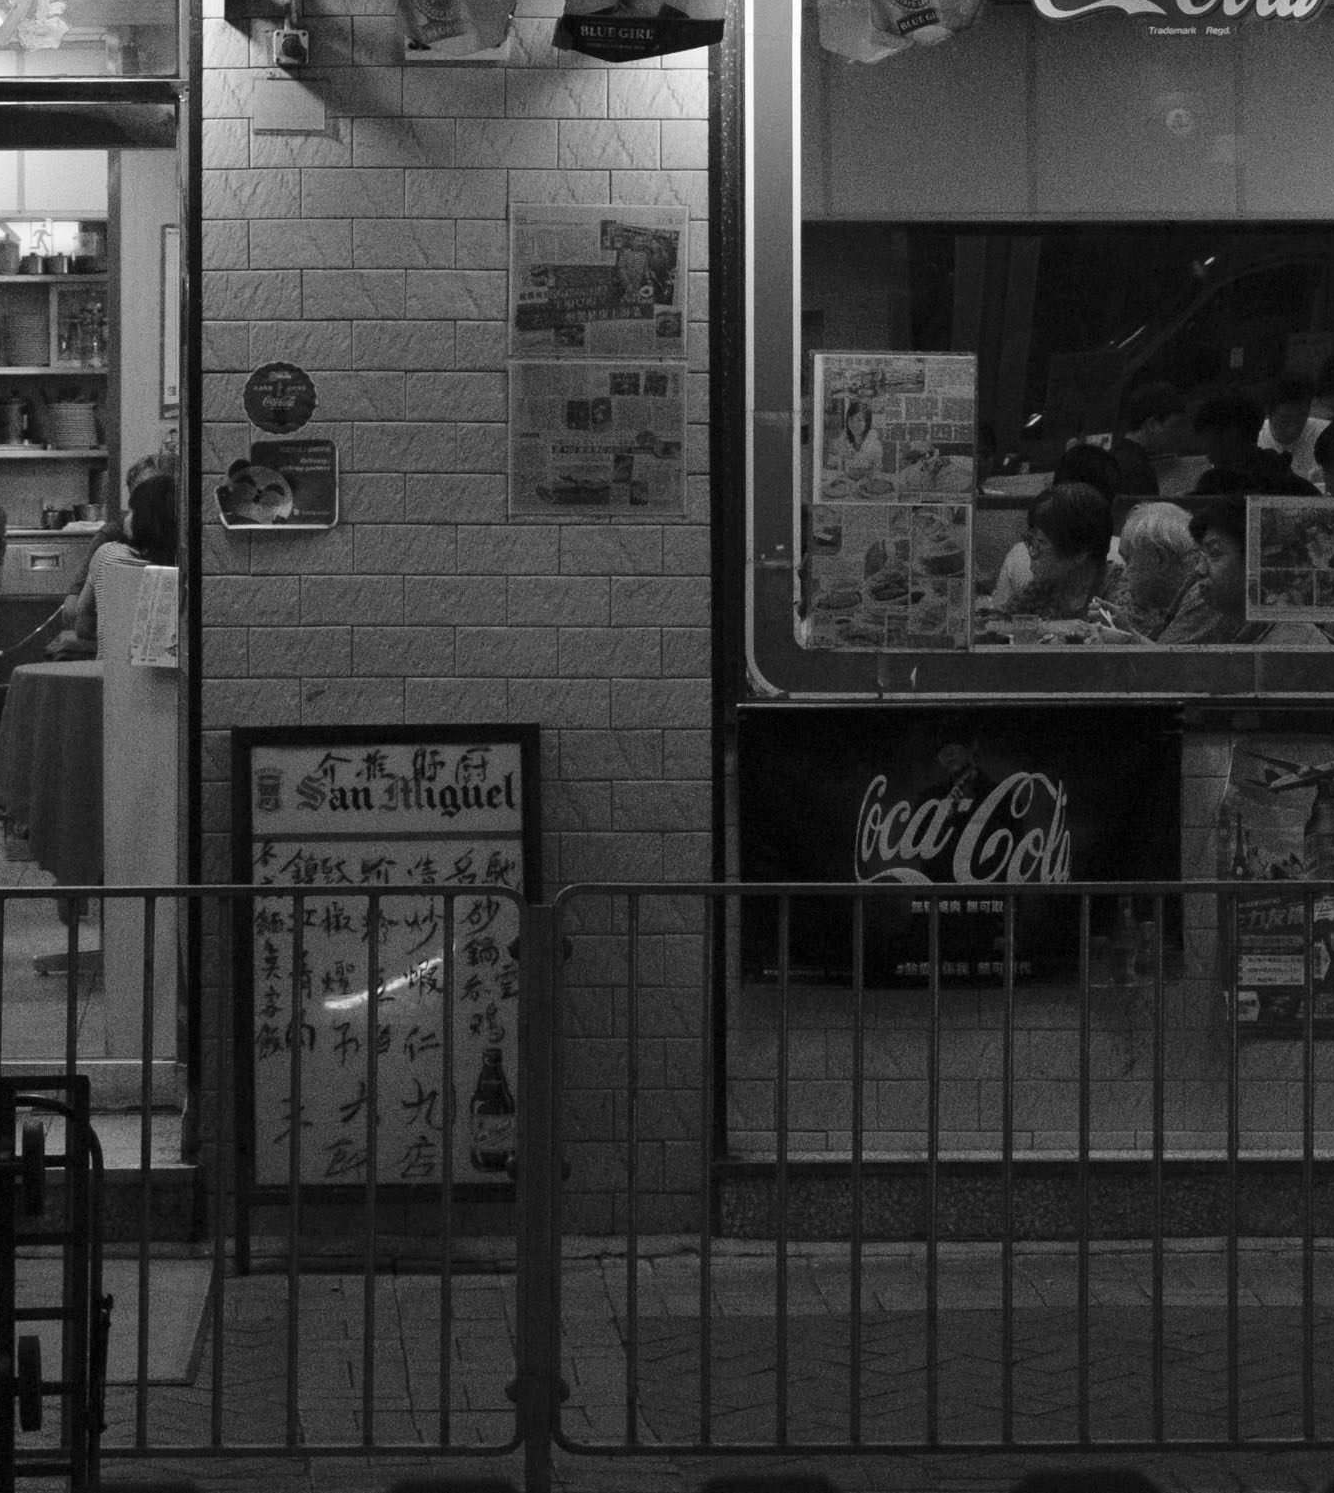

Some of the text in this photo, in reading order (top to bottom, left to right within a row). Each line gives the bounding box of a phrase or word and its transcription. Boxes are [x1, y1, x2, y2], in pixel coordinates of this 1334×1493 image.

[580, 24, 655, 40] BLUE GIRL
[295, 770, 517, 819] San Miguel
